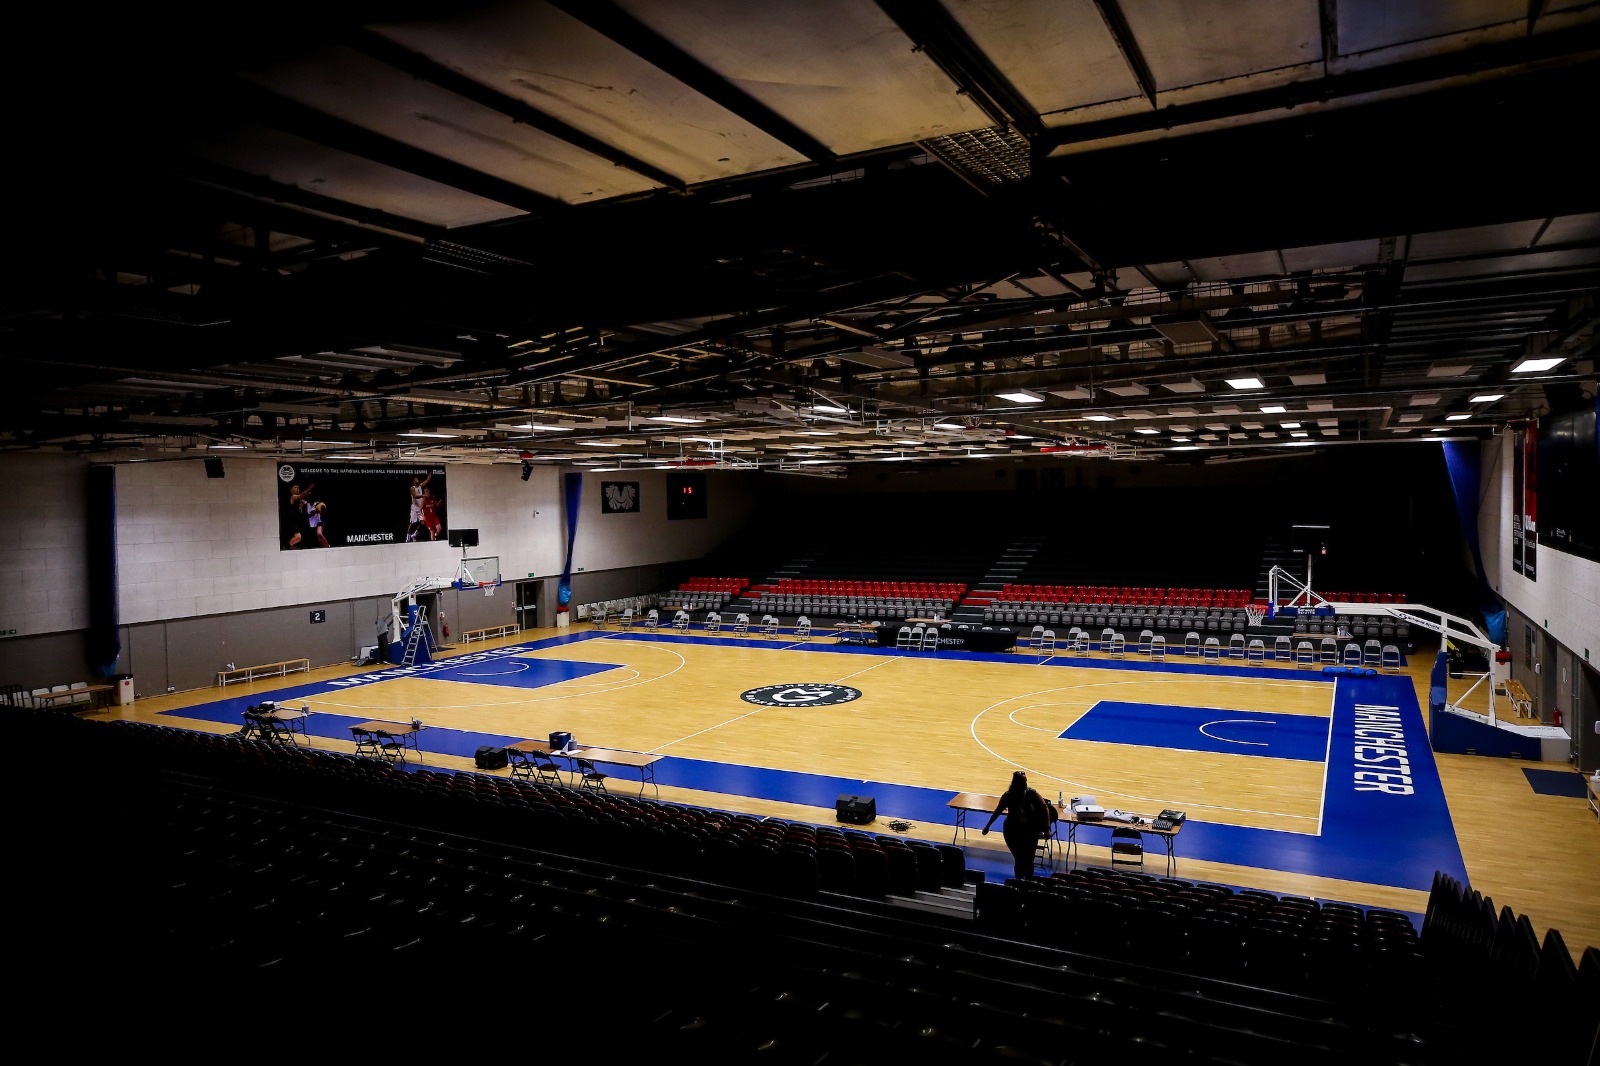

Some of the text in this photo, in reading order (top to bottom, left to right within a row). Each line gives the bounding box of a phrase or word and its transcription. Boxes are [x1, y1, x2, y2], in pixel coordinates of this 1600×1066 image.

[346, 532, 394, 543] MANCHESTER
[314, 612, 321, 621] 2
[327, 647, 533, 686] MANCHESTER
[1354, 703, 1414, 796] MANCHESTER
